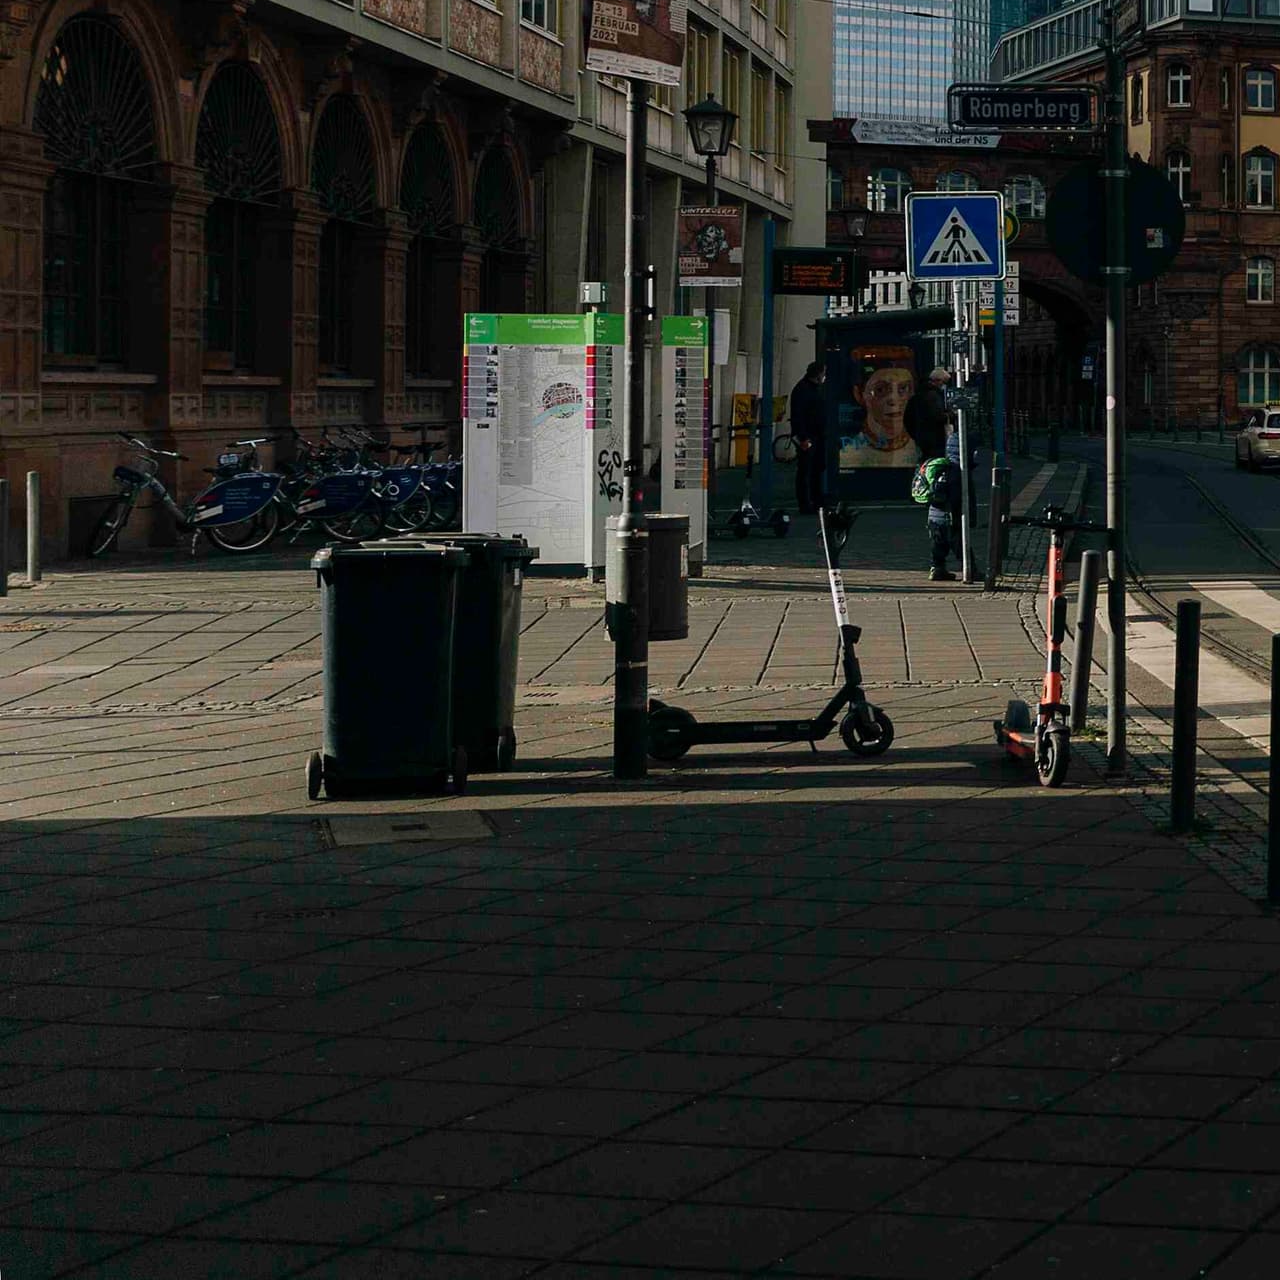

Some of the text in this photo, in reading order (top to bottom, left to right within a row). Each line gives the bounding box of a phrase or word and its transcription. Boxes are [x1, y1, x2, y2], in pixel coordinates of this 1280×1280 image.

[594, 16, 637, 33] FEBRUAR
[592, 29, 615, 41] 2022
[970, 97, 1081, 121] Römerberg
[935, 135, 988, 144] und der NS
[1006, 281, 1015, 289] 12
[980, 297, 994, 305] N12
[1005, 297, 1014, 305] 14
[834, 579, 847, 614] BIRD
